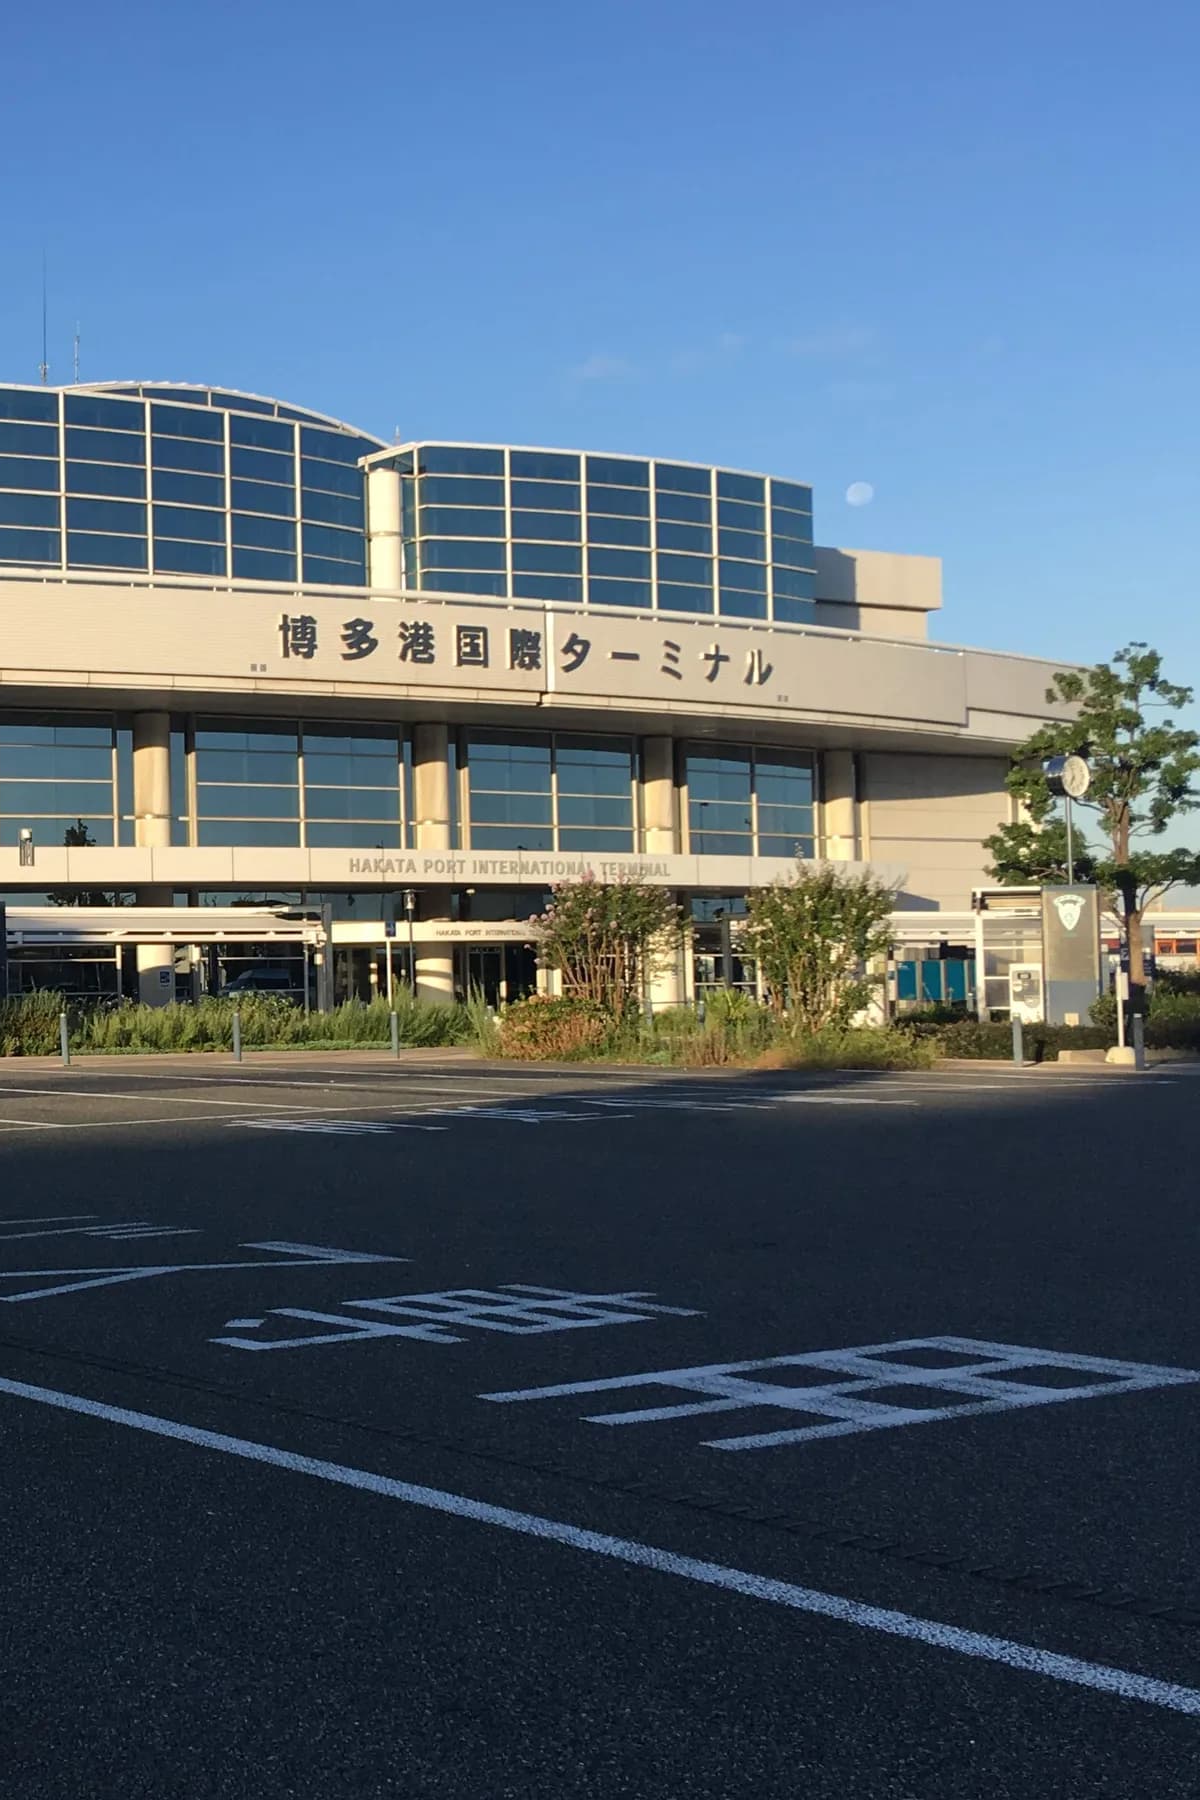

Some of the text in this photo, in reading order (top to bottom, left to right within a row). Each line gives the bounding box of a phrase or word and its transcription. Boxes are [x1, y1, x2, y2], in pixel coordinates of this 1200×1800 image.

[279, 613, 773, 686] 博多港国際ターミナル
[349, 858, 671, 877] HAKATA PORT INTERNATIONAL TERMINAL
